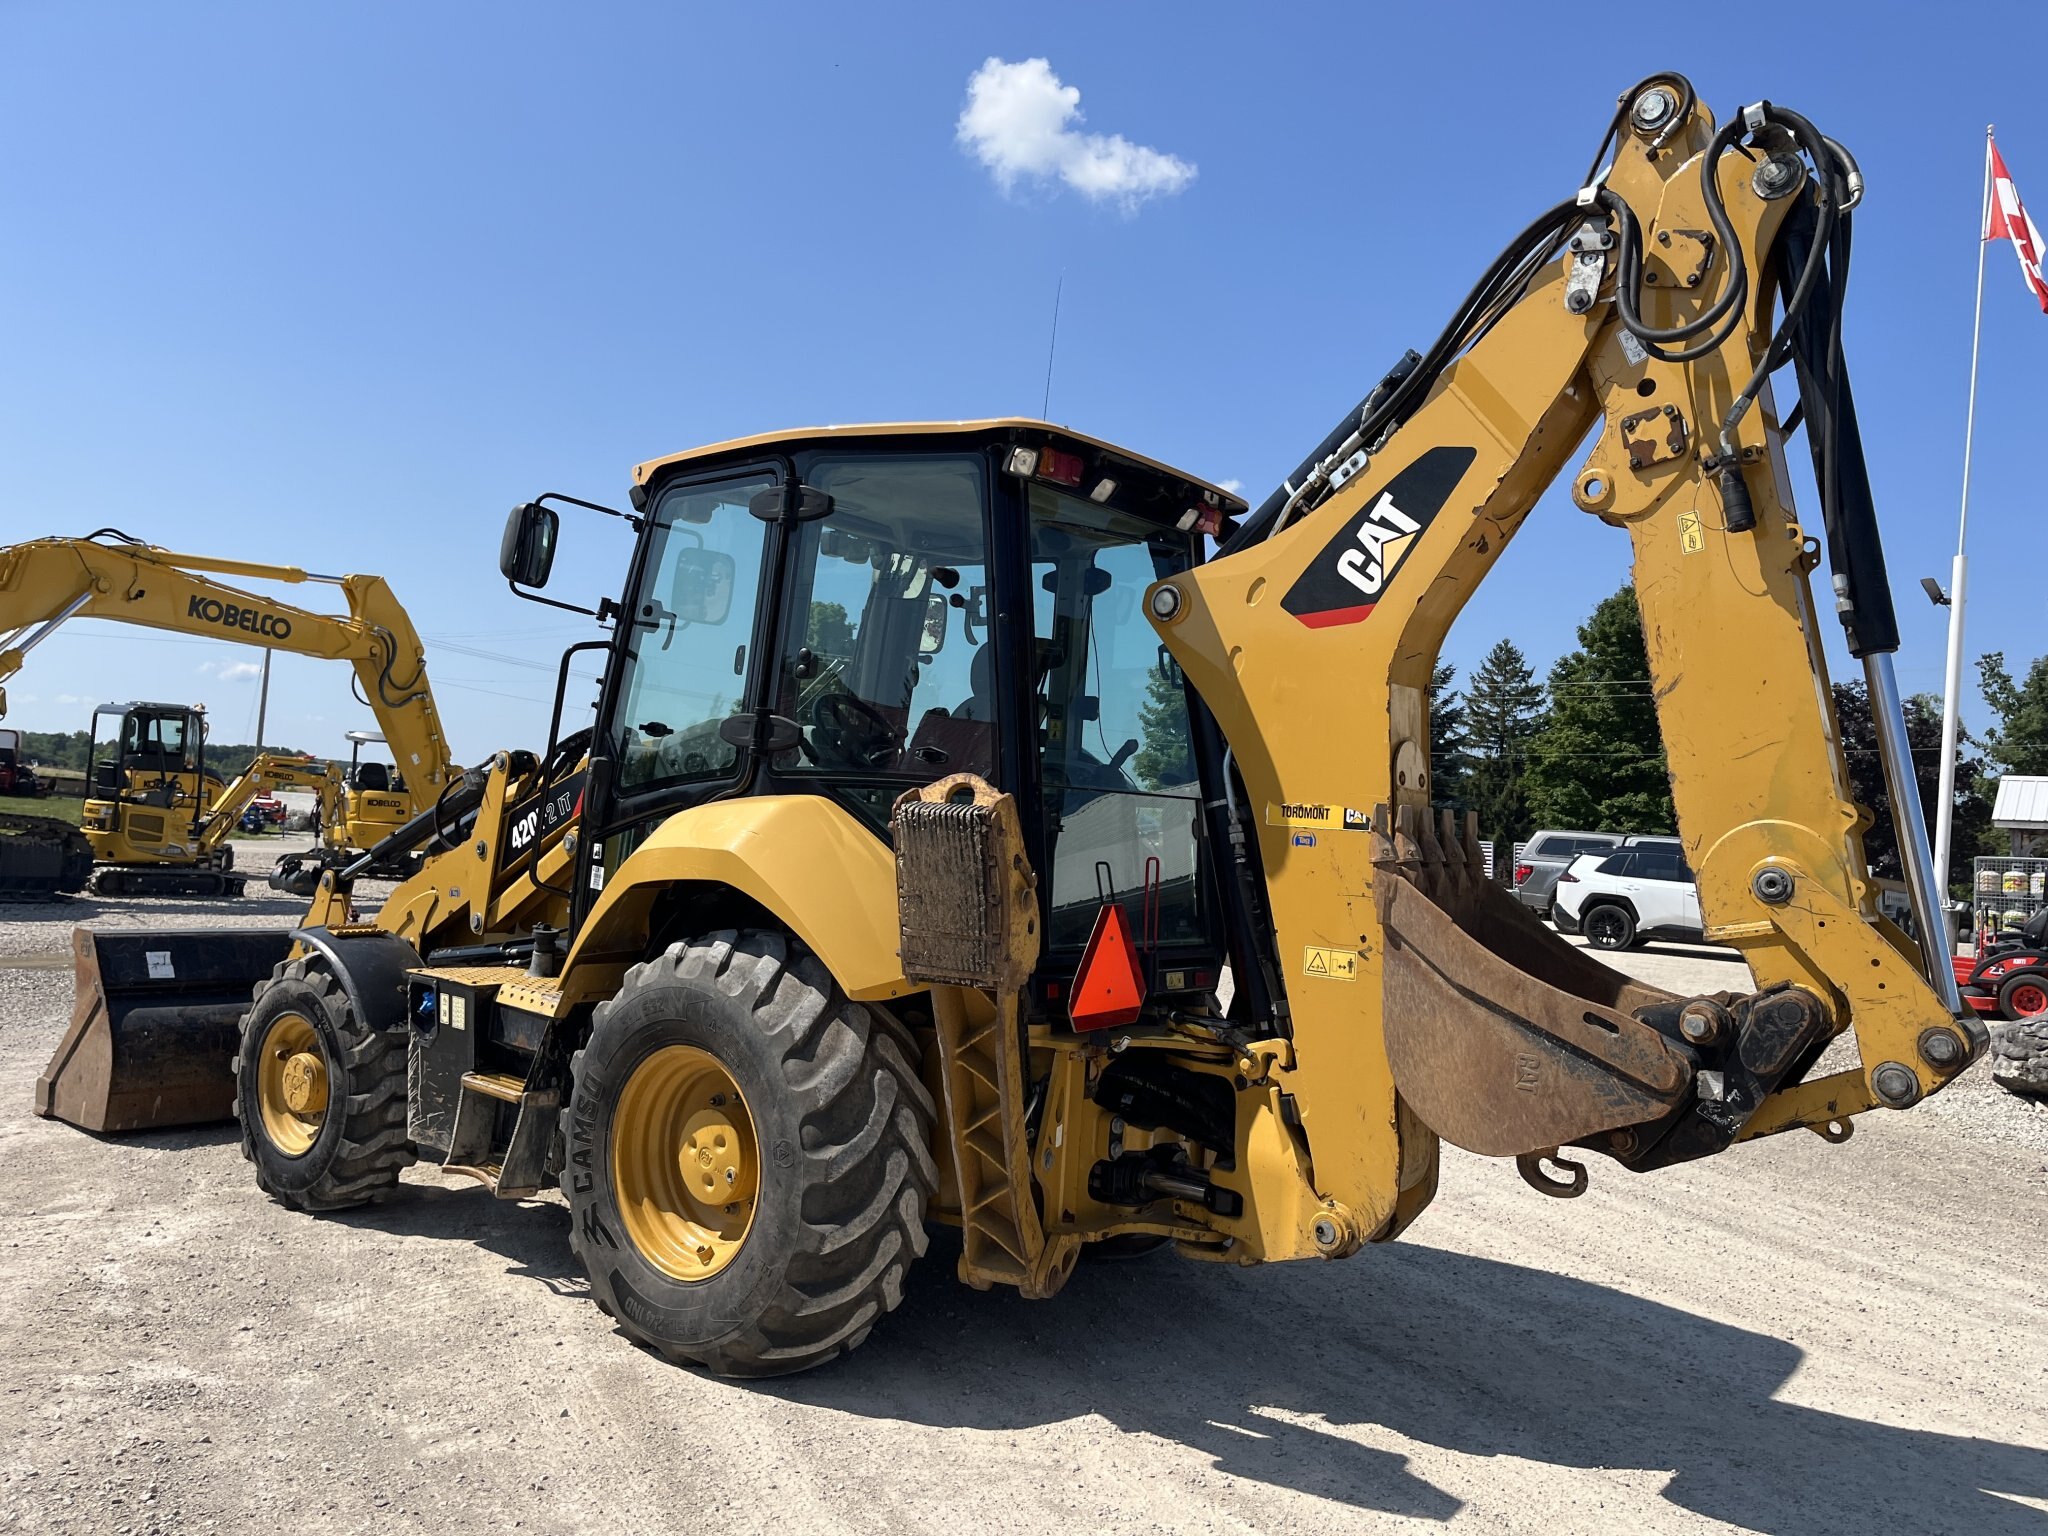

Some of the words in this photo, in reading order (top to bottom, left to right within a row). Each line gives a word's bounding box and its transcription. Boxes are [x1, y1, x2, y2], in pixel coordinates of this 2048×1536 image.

[1336, 491, 1422, 595] CAT
[188, 595, 291, 639] KOBELCO
[264, 770, 294, 781] KOBELCO
[367, 799, 401, 807] KOBELCO
[512, 802, 557, 848] 4202
[557, 791, 571, 816] IT
[1282, 805, 1330, 820] TOROMONT
[1345, 808, 1367, 824] CAT
[1514, 1053, 1541, 1095] CAT
[571, 1071, 605, 1195] CAMSO
[624, 1296, 645, 1320] IND
